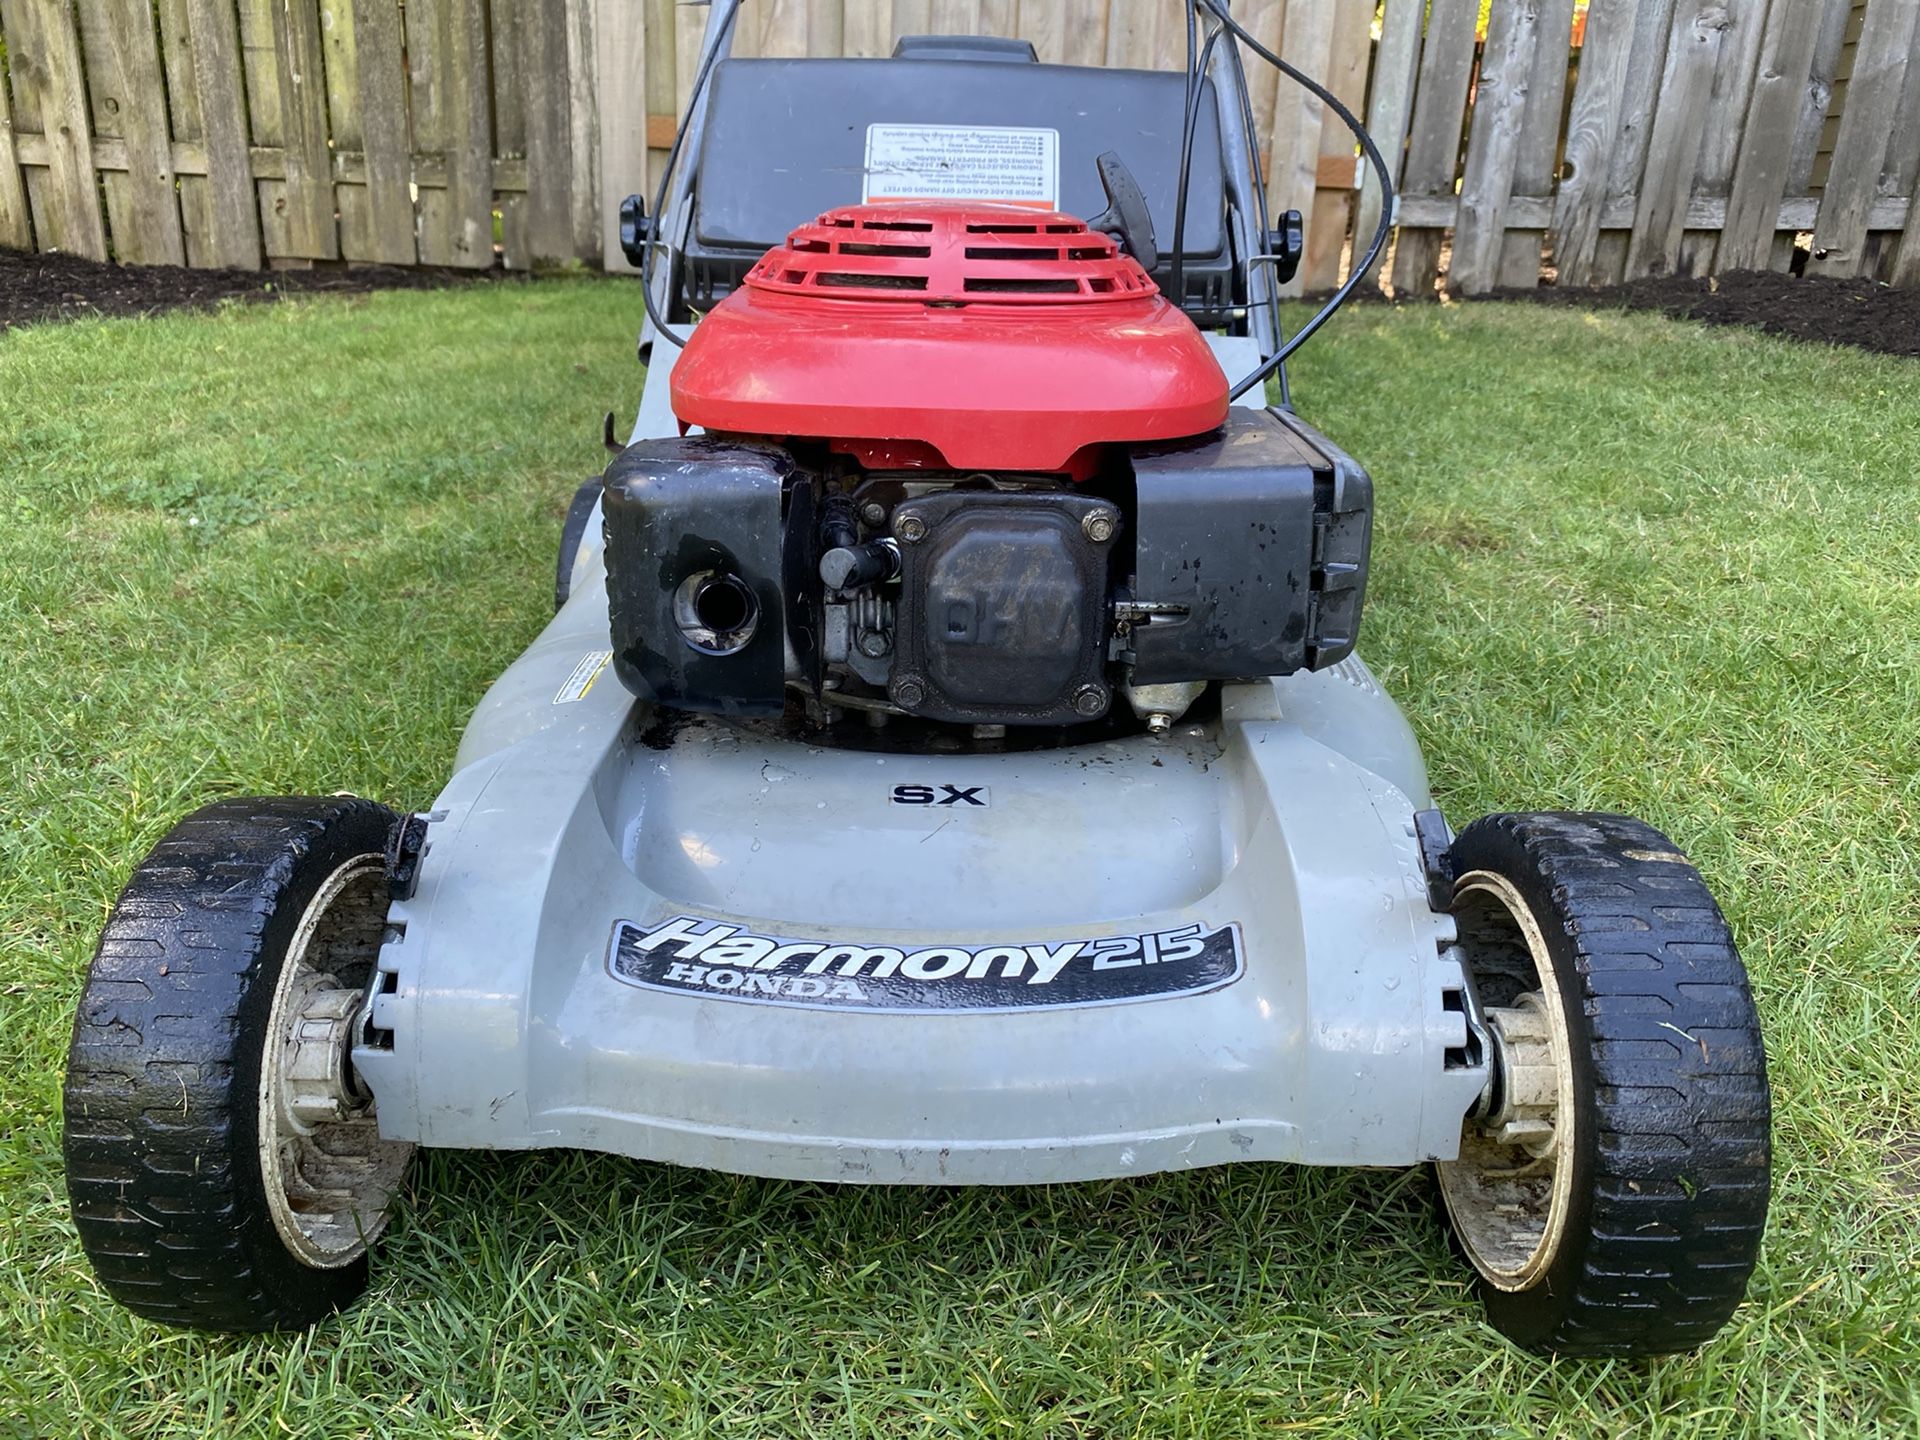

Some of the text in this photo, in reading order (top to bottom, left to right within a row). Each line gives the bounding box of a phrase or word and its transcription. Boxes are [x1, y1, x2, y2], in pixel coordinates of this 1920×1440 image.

[893, 785, 987, 807] SX
[632, 916, 1205, 986] Harmony 215
[661, 961, 870, 1001] HONDA
